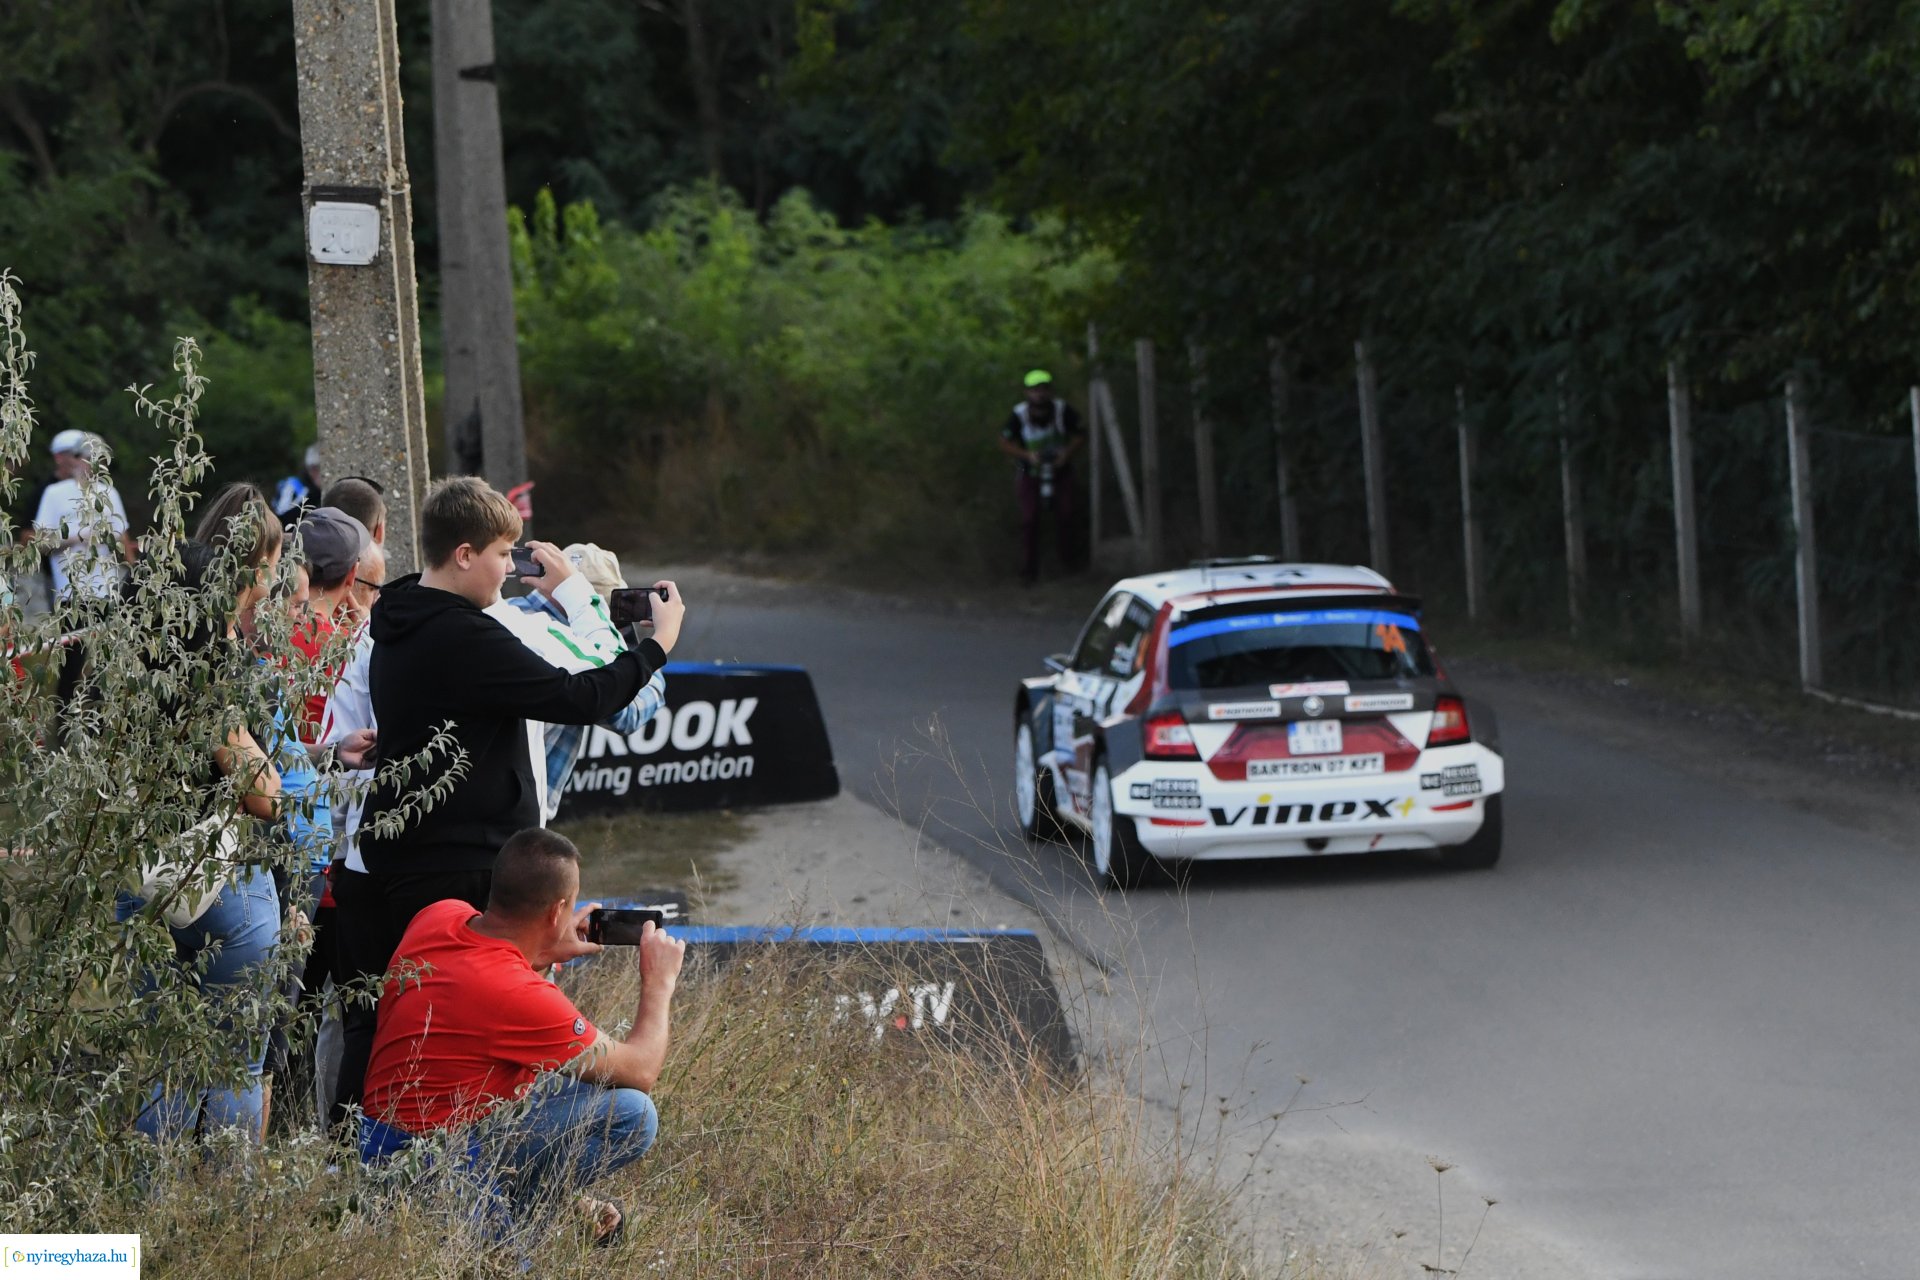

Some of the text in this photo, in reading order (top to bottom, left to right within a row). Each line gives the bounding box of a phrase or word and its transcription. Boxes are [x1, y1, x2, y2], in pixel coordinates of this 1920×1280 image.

[638, 752, 754, 787] emotion
[1250, 762, 1322, 776] BARTRON
[1350, 757, 1378, 771] KFT
